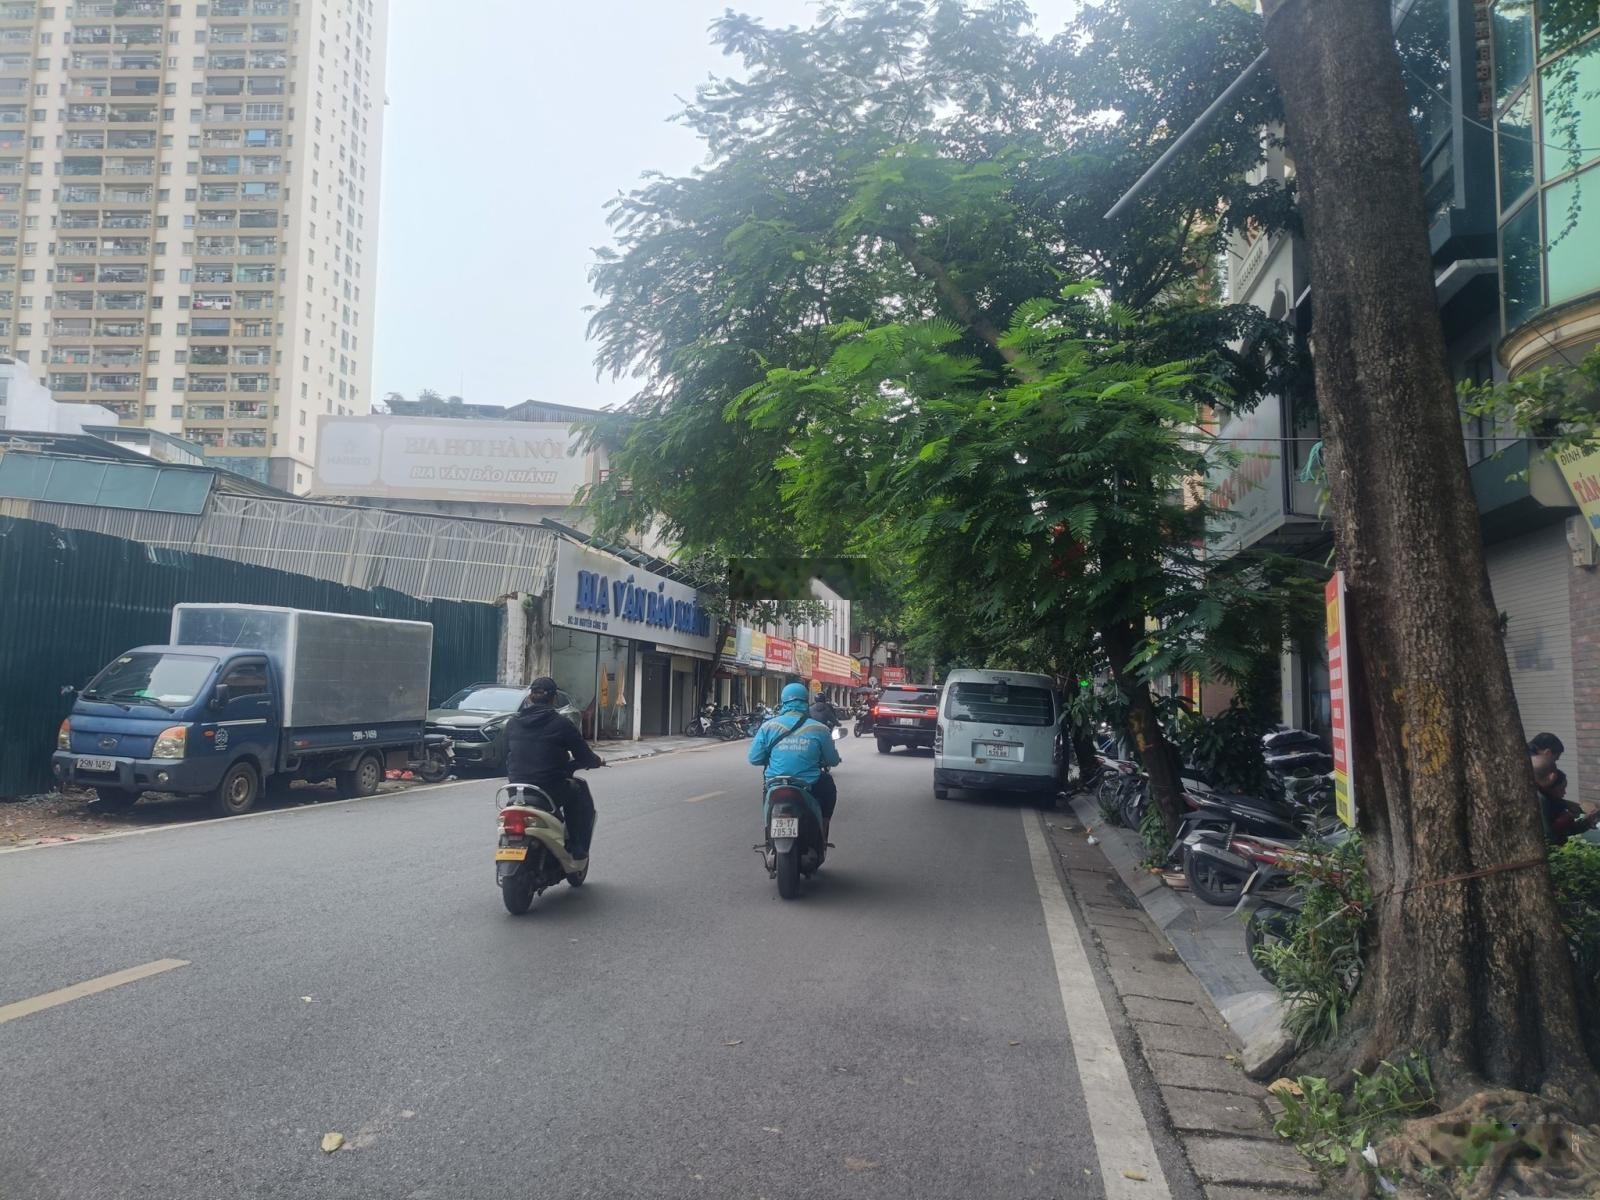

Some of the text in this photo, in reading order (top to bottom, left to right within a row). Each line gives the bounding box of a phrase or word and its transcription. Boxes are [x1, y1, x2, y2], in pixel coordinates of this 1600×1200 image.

[404, 436, 441, 455] BIA
[488, 436, 521, 457] HÀ
[522, 438, 566, 464] NỘI
[409, 465, 435, 480] BIA
[576, 569, 610, 613] BIA
